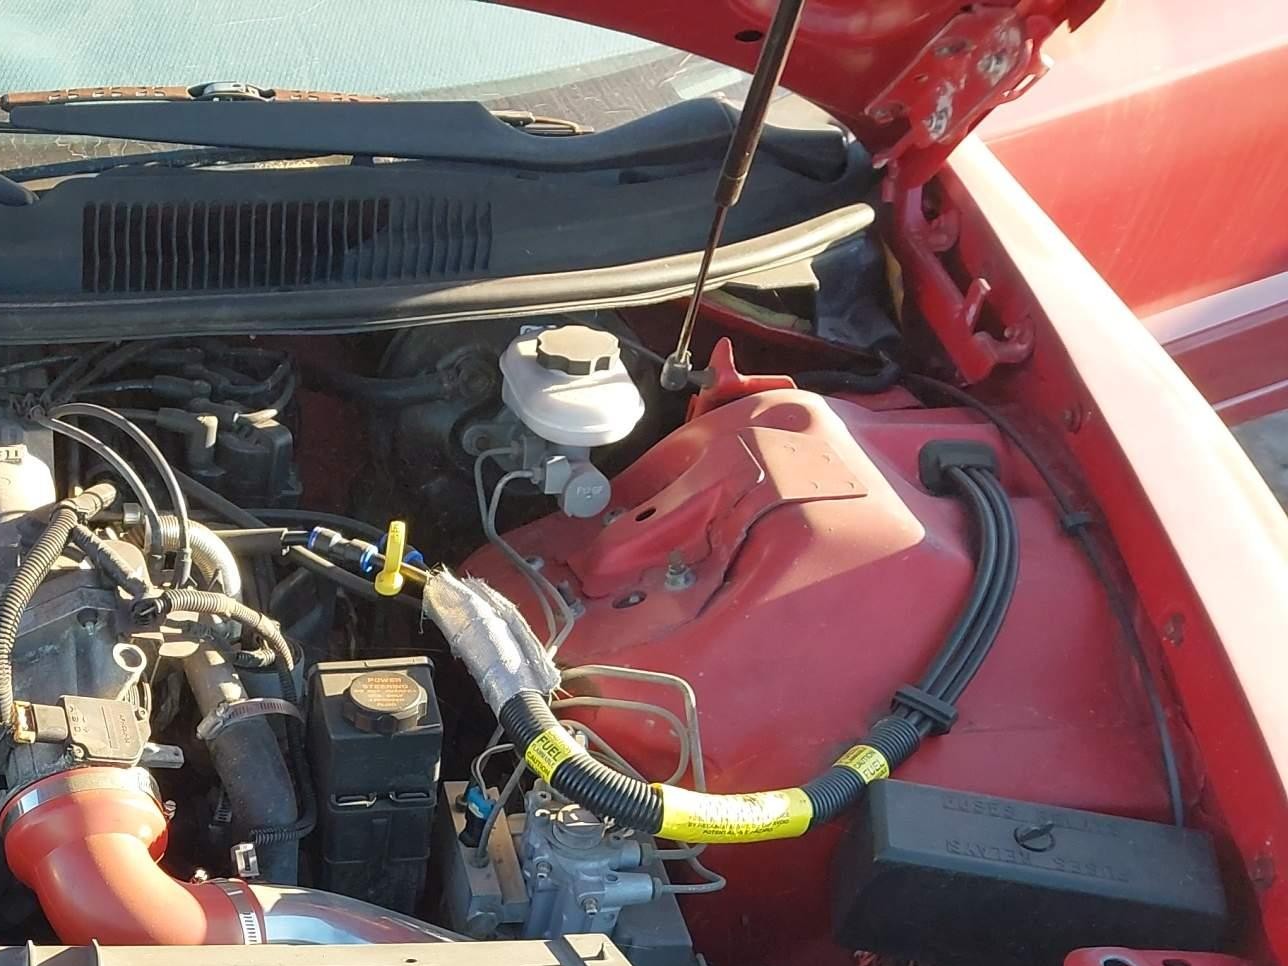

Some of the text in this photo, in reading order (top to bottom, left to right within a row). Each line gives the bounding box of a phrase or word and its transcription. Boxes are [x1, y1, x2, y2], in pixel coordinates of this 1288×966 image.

[536, 735, 563, 762] FUEL
[526, 751, 551, 776] CAUTION
[862, 758, 886, 777] FUEL
